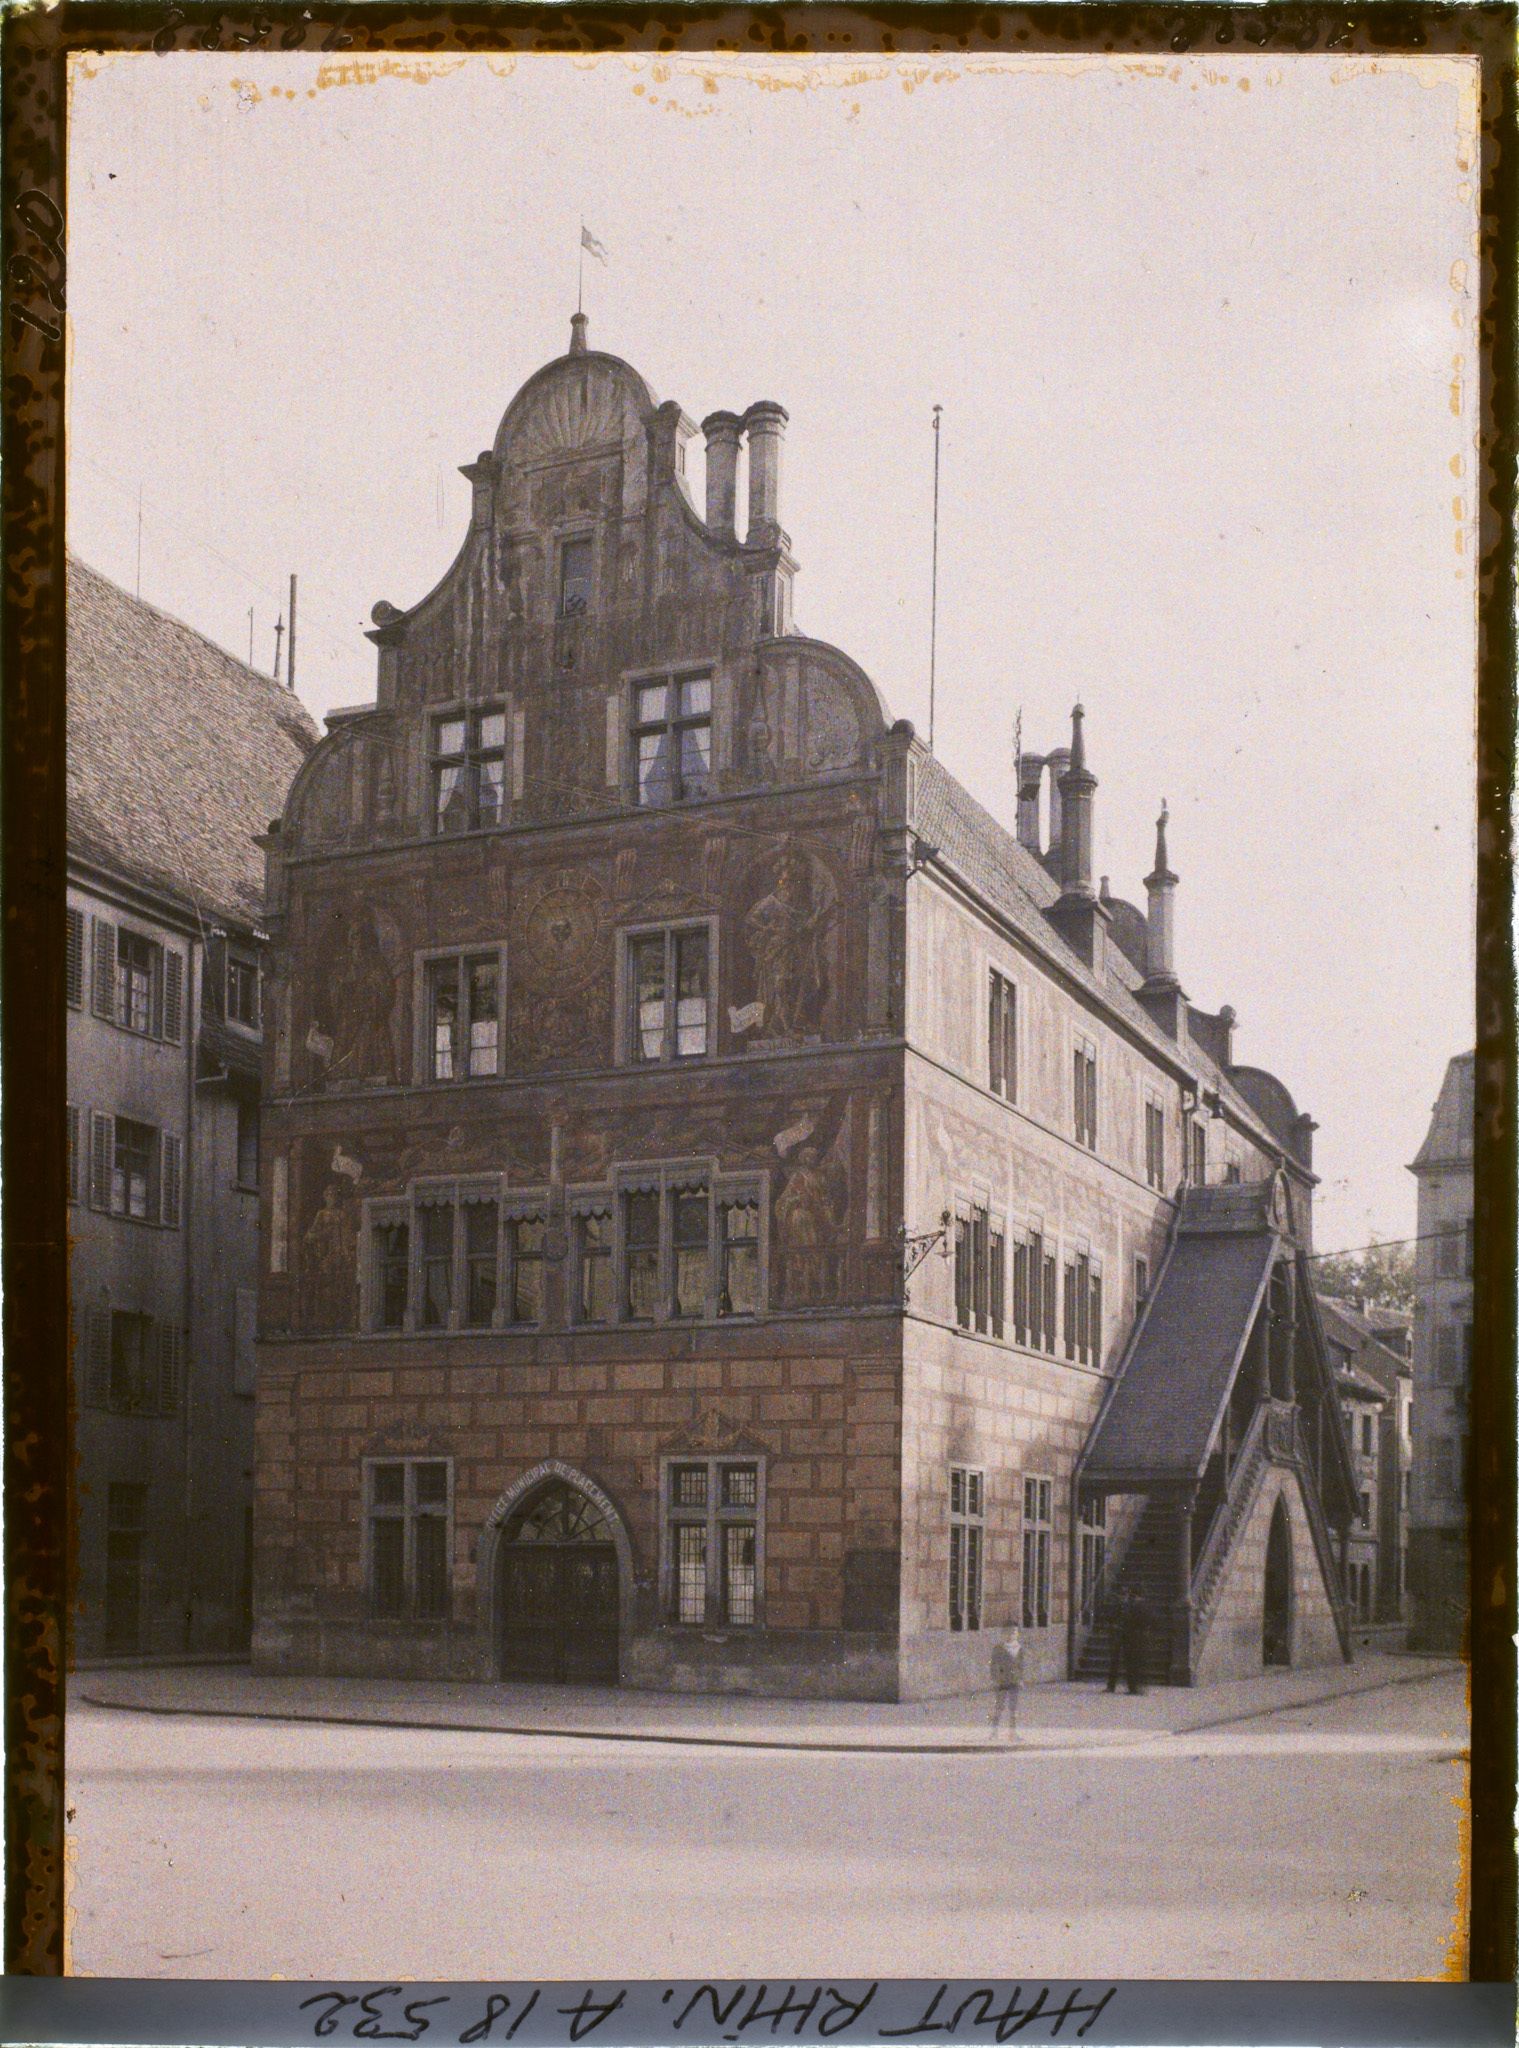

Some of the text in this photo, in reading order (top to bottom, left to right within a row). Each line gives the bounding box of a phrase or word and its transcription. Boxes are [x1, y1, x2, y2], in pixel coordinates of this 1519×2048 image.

[486, 1461, 620, 1529] OFFICE MUNICIPAL DE PLACEMENT
[557, 1989, 628, 2042] A
[878, 1983, 1118, 2043] HAUT
